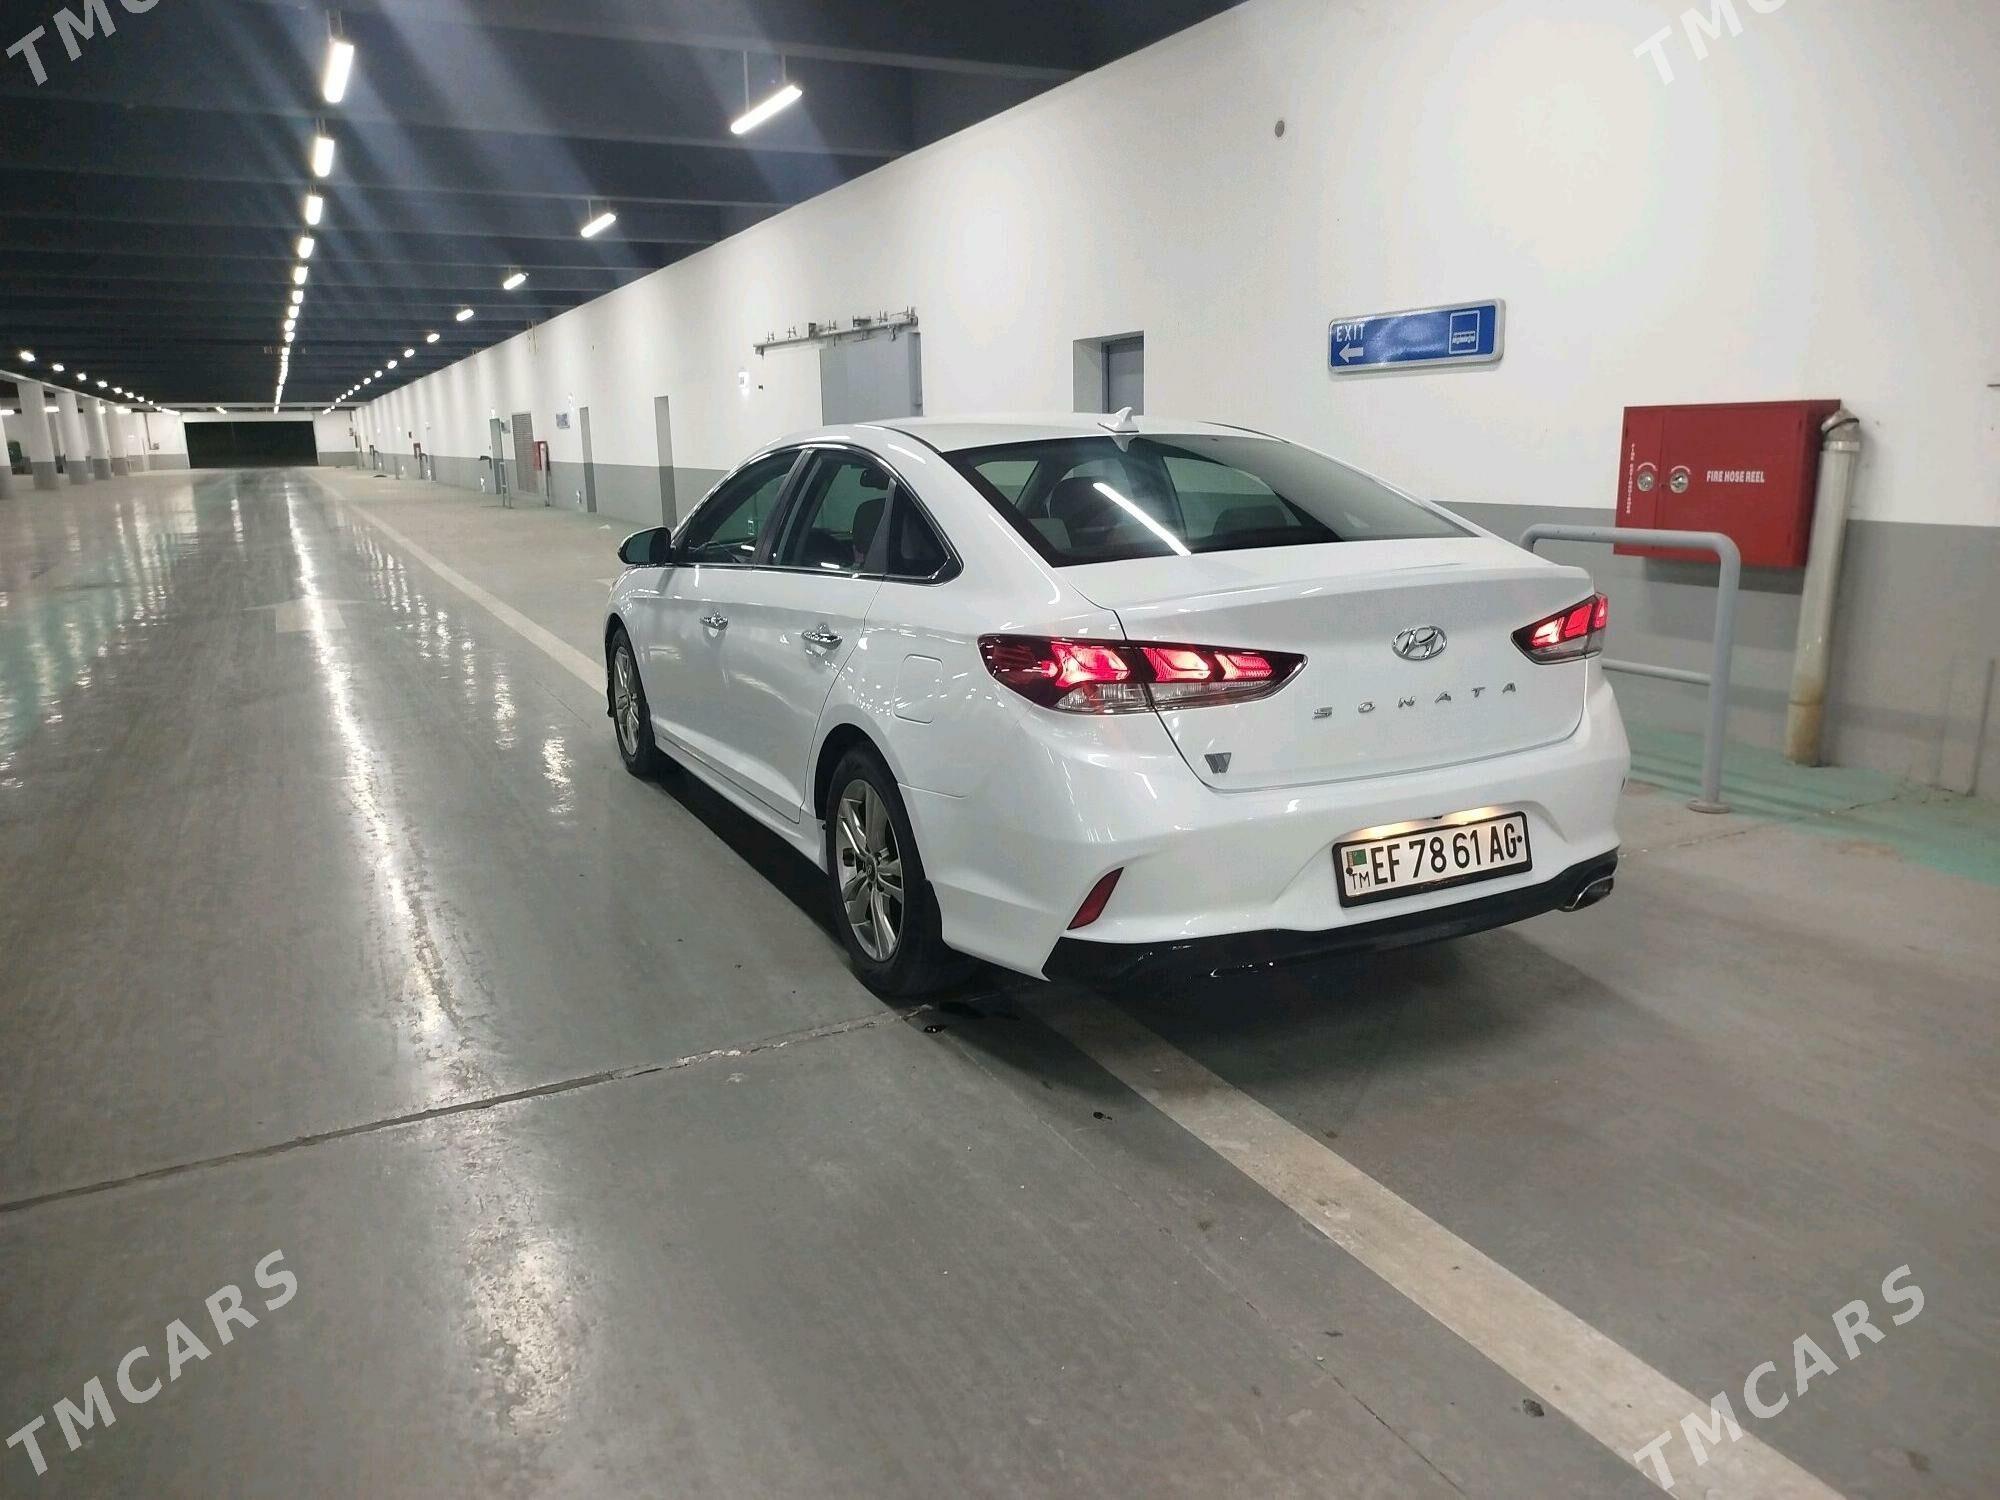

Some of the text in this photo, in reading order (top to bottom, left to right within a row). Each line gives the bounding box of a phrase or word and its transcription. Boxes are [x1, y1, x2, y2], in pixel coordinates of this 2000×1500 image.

[1336, 324, 1365, 342] EXIT
[1706, 470, 1765, 483] FIRE HOSE REEL
[1312, 682, 1517, 720] SONATA
[1371, 823, 1517, 885] EF 78 61 AG
[1351, 871, 1370, 890] TM
